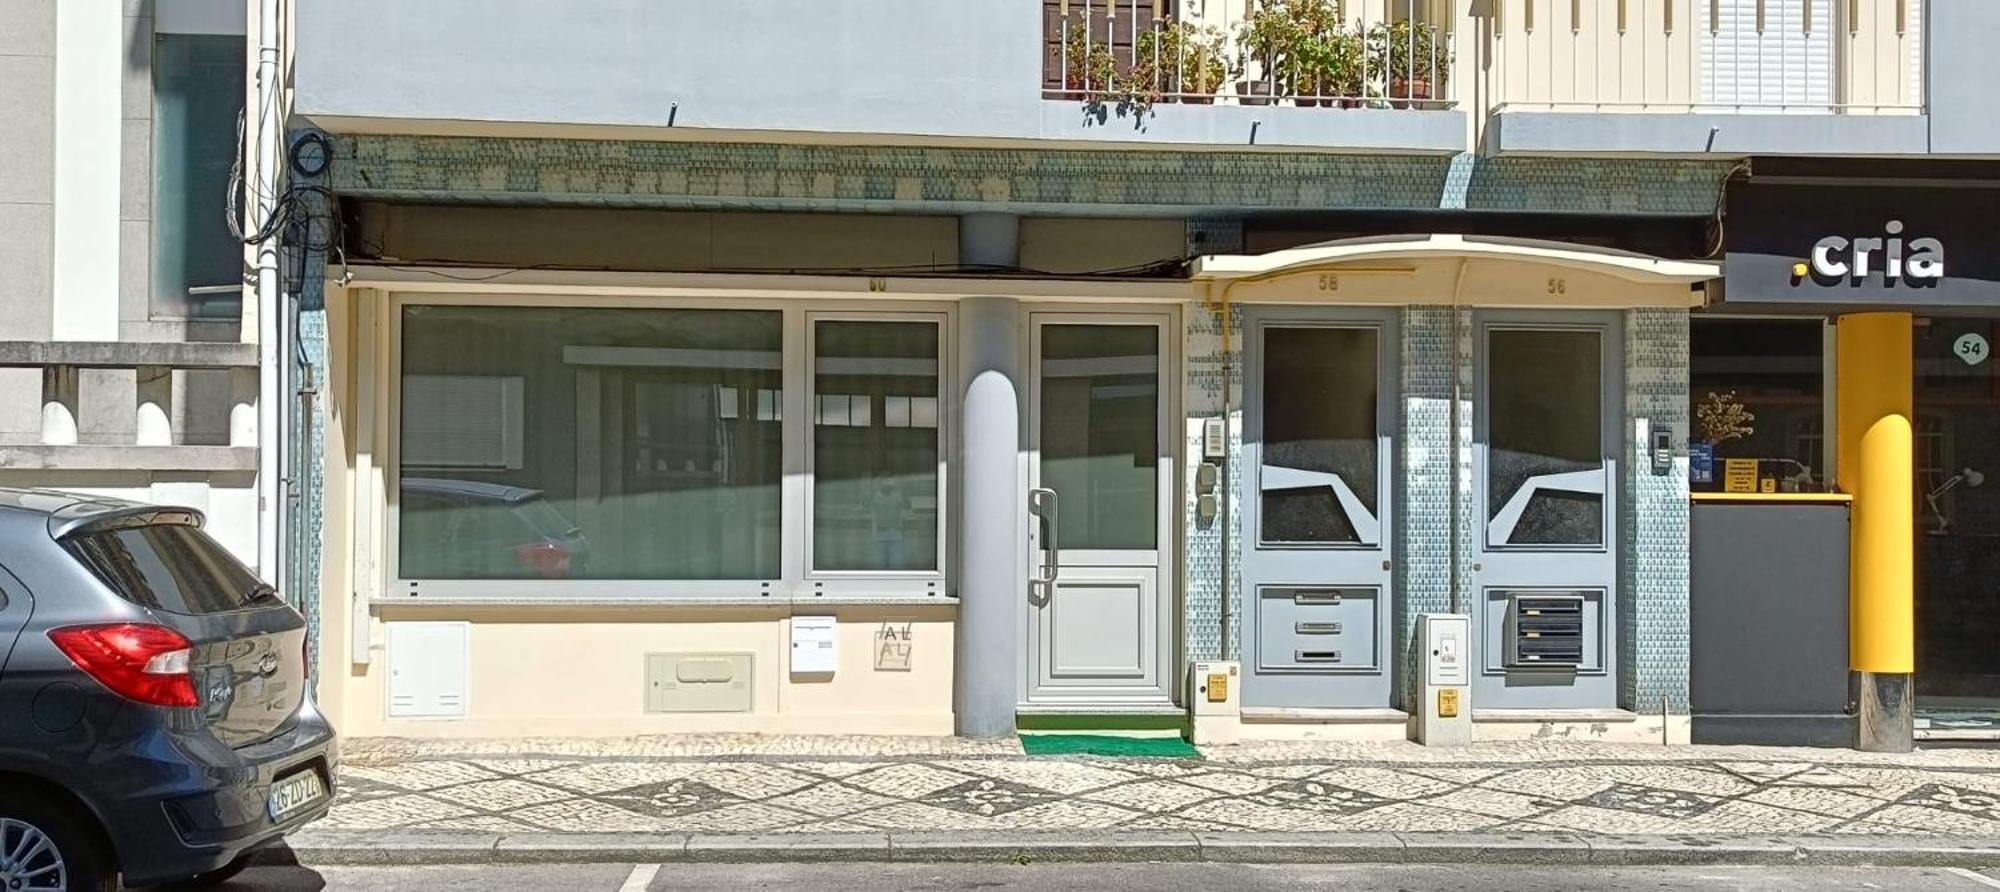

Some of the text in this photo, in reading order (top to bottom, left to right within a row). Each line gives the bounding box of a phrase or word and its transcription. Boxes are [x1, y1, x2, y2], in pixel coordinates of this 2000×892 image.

[1319, 274, 1338, 291] 58
[1547, 278, 1566, 294] 56
[1961, 340, 1981, 355] 54
